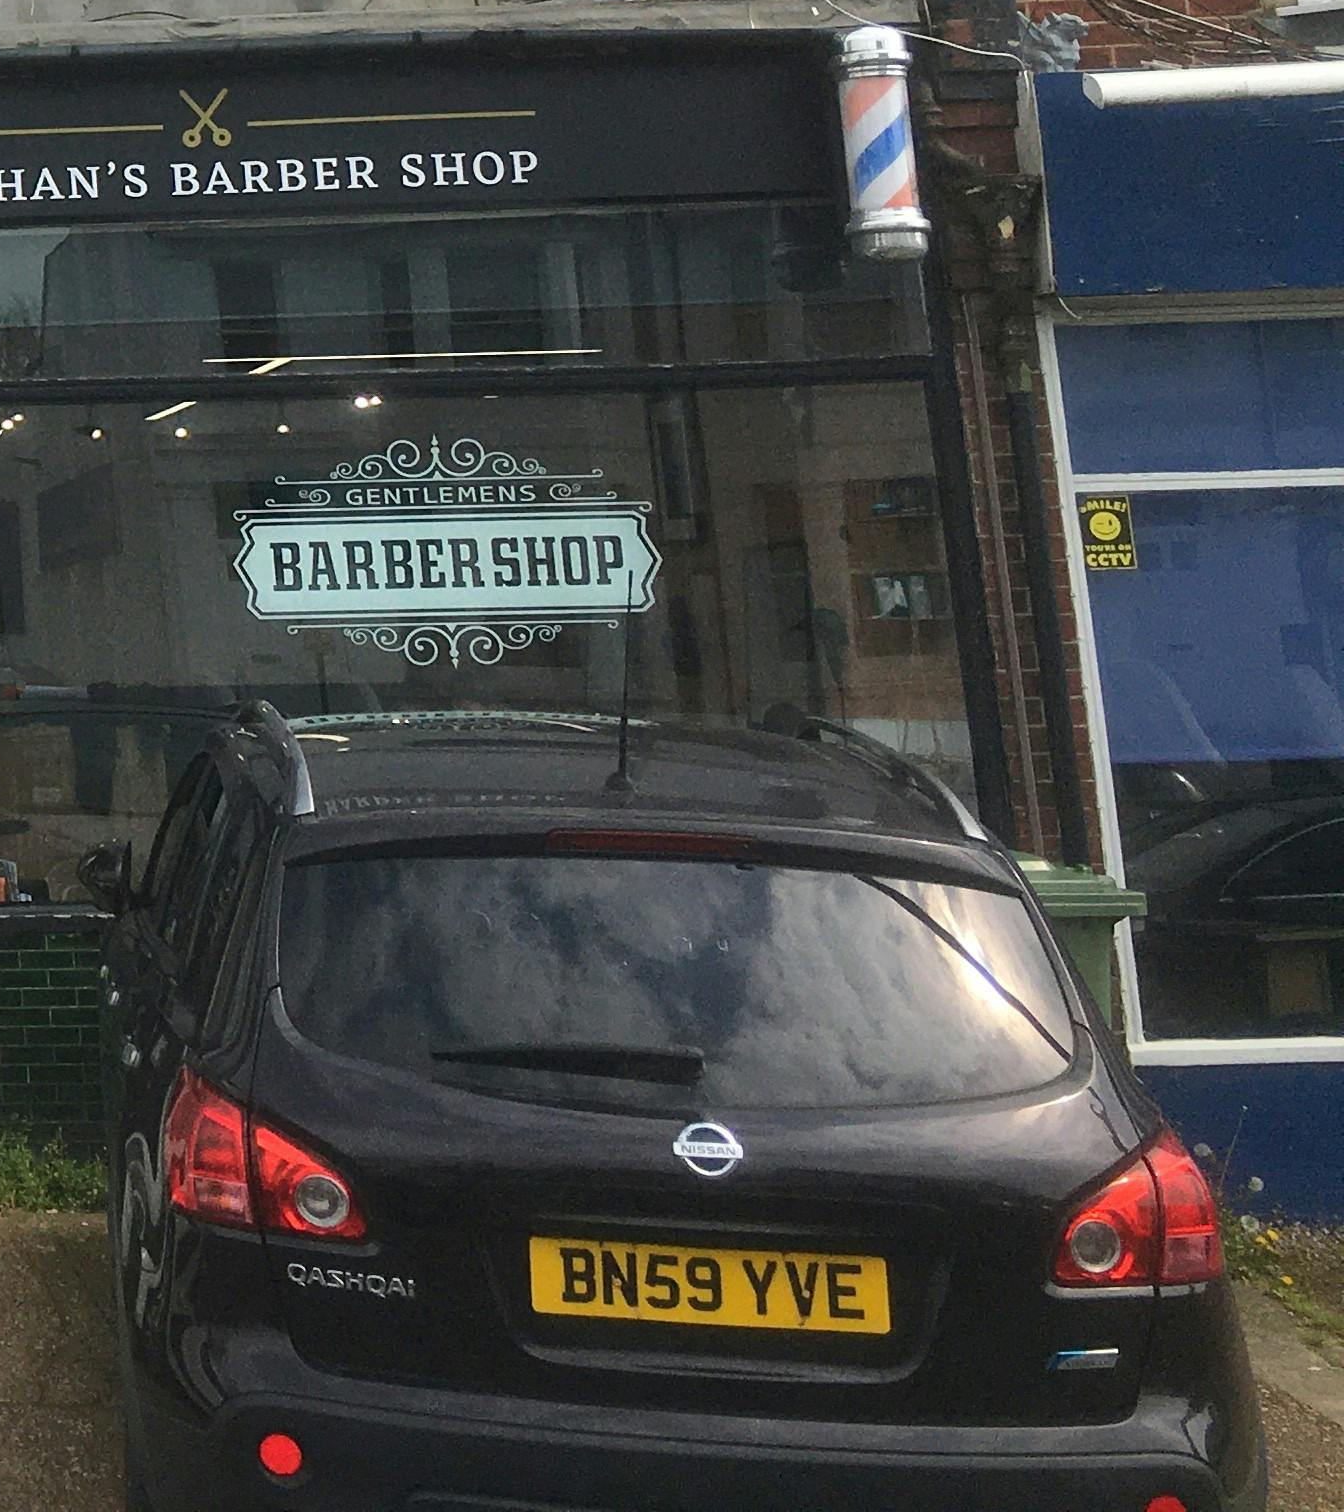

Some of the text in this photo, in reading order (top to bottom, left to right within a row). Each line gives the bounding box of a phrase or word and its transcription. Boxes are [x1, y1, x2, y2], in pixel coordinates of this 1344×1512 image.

[170, 153, 379, 198] BARBER
[401, 149, 540, 190] SHOP
[344, 484, 537, 507] GENTLEMENS
[1086, 553, 1132, 567] CCTV
[681, 1144, 737, 1156] NISSAN
[287, 1262, 416, 1300] QASHQAI
[561, 1243, 867, 1321] BN59 YVE
